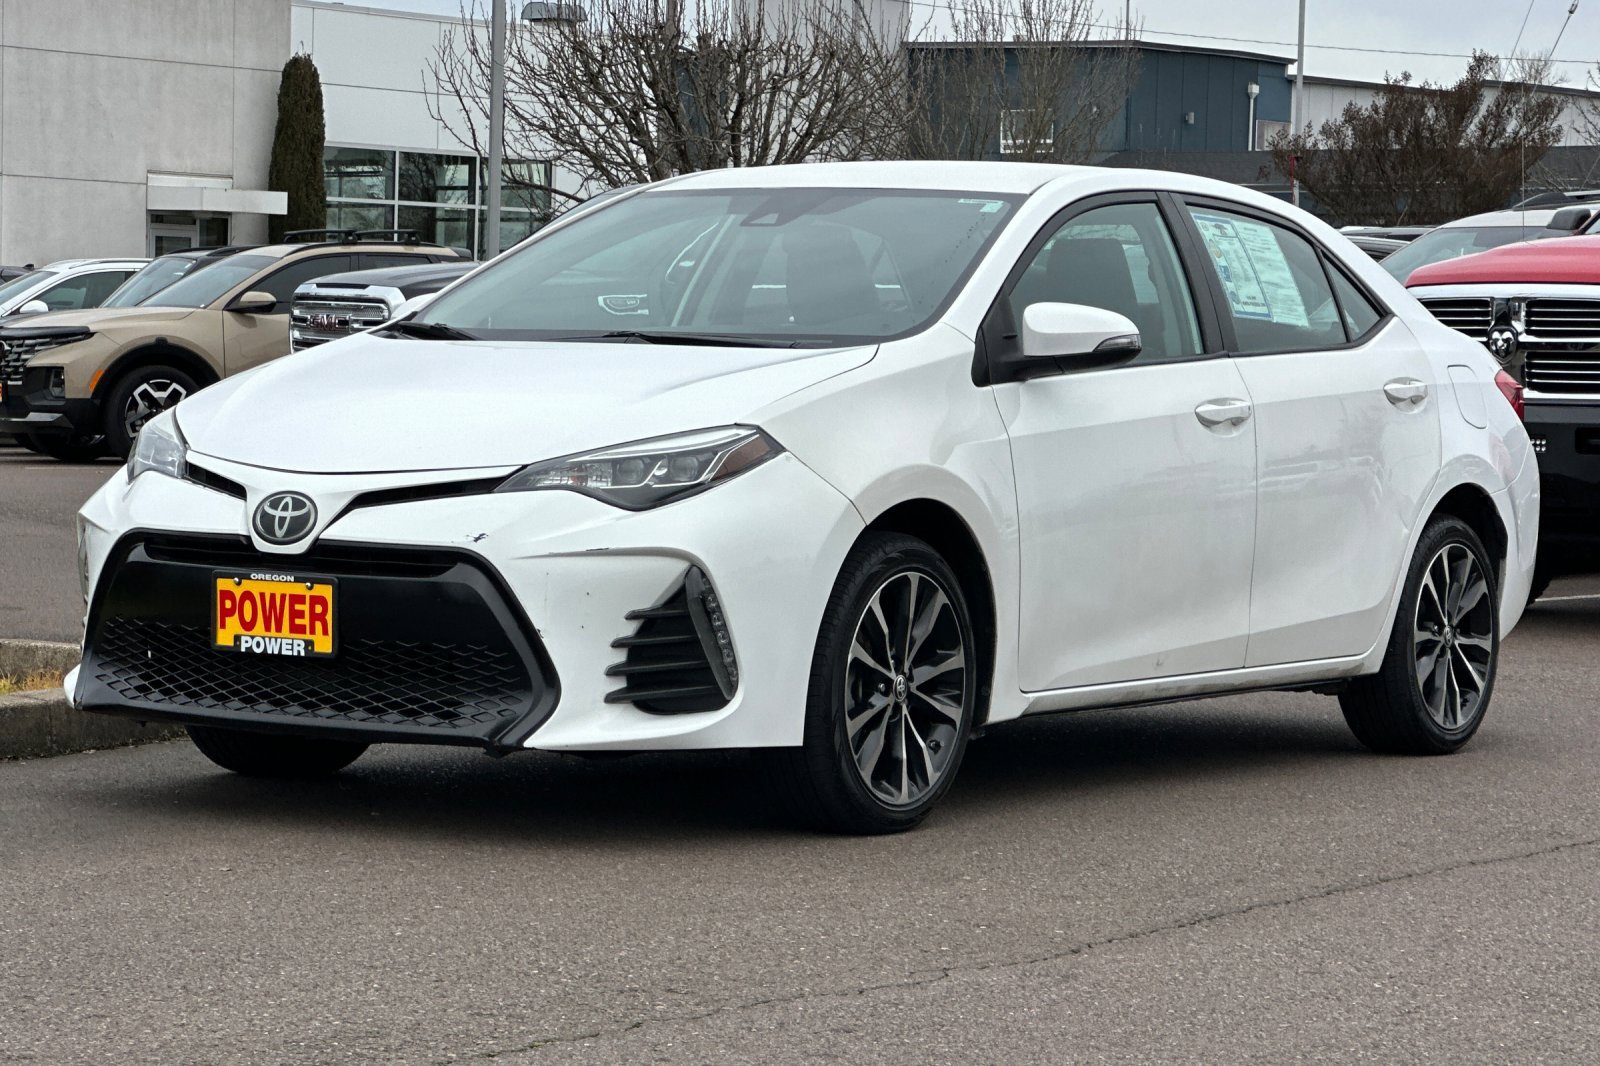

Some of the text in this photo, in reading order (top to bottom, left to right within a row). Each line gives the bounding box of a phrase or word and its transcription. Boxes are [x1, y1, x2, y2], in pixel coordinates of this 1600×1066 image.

[308, 314, 350, 331] GMC
[250, 573, 295, 583] OREGON
[218, 589, 330, 637] POWER
[240, 635, 306, 657] POWER
